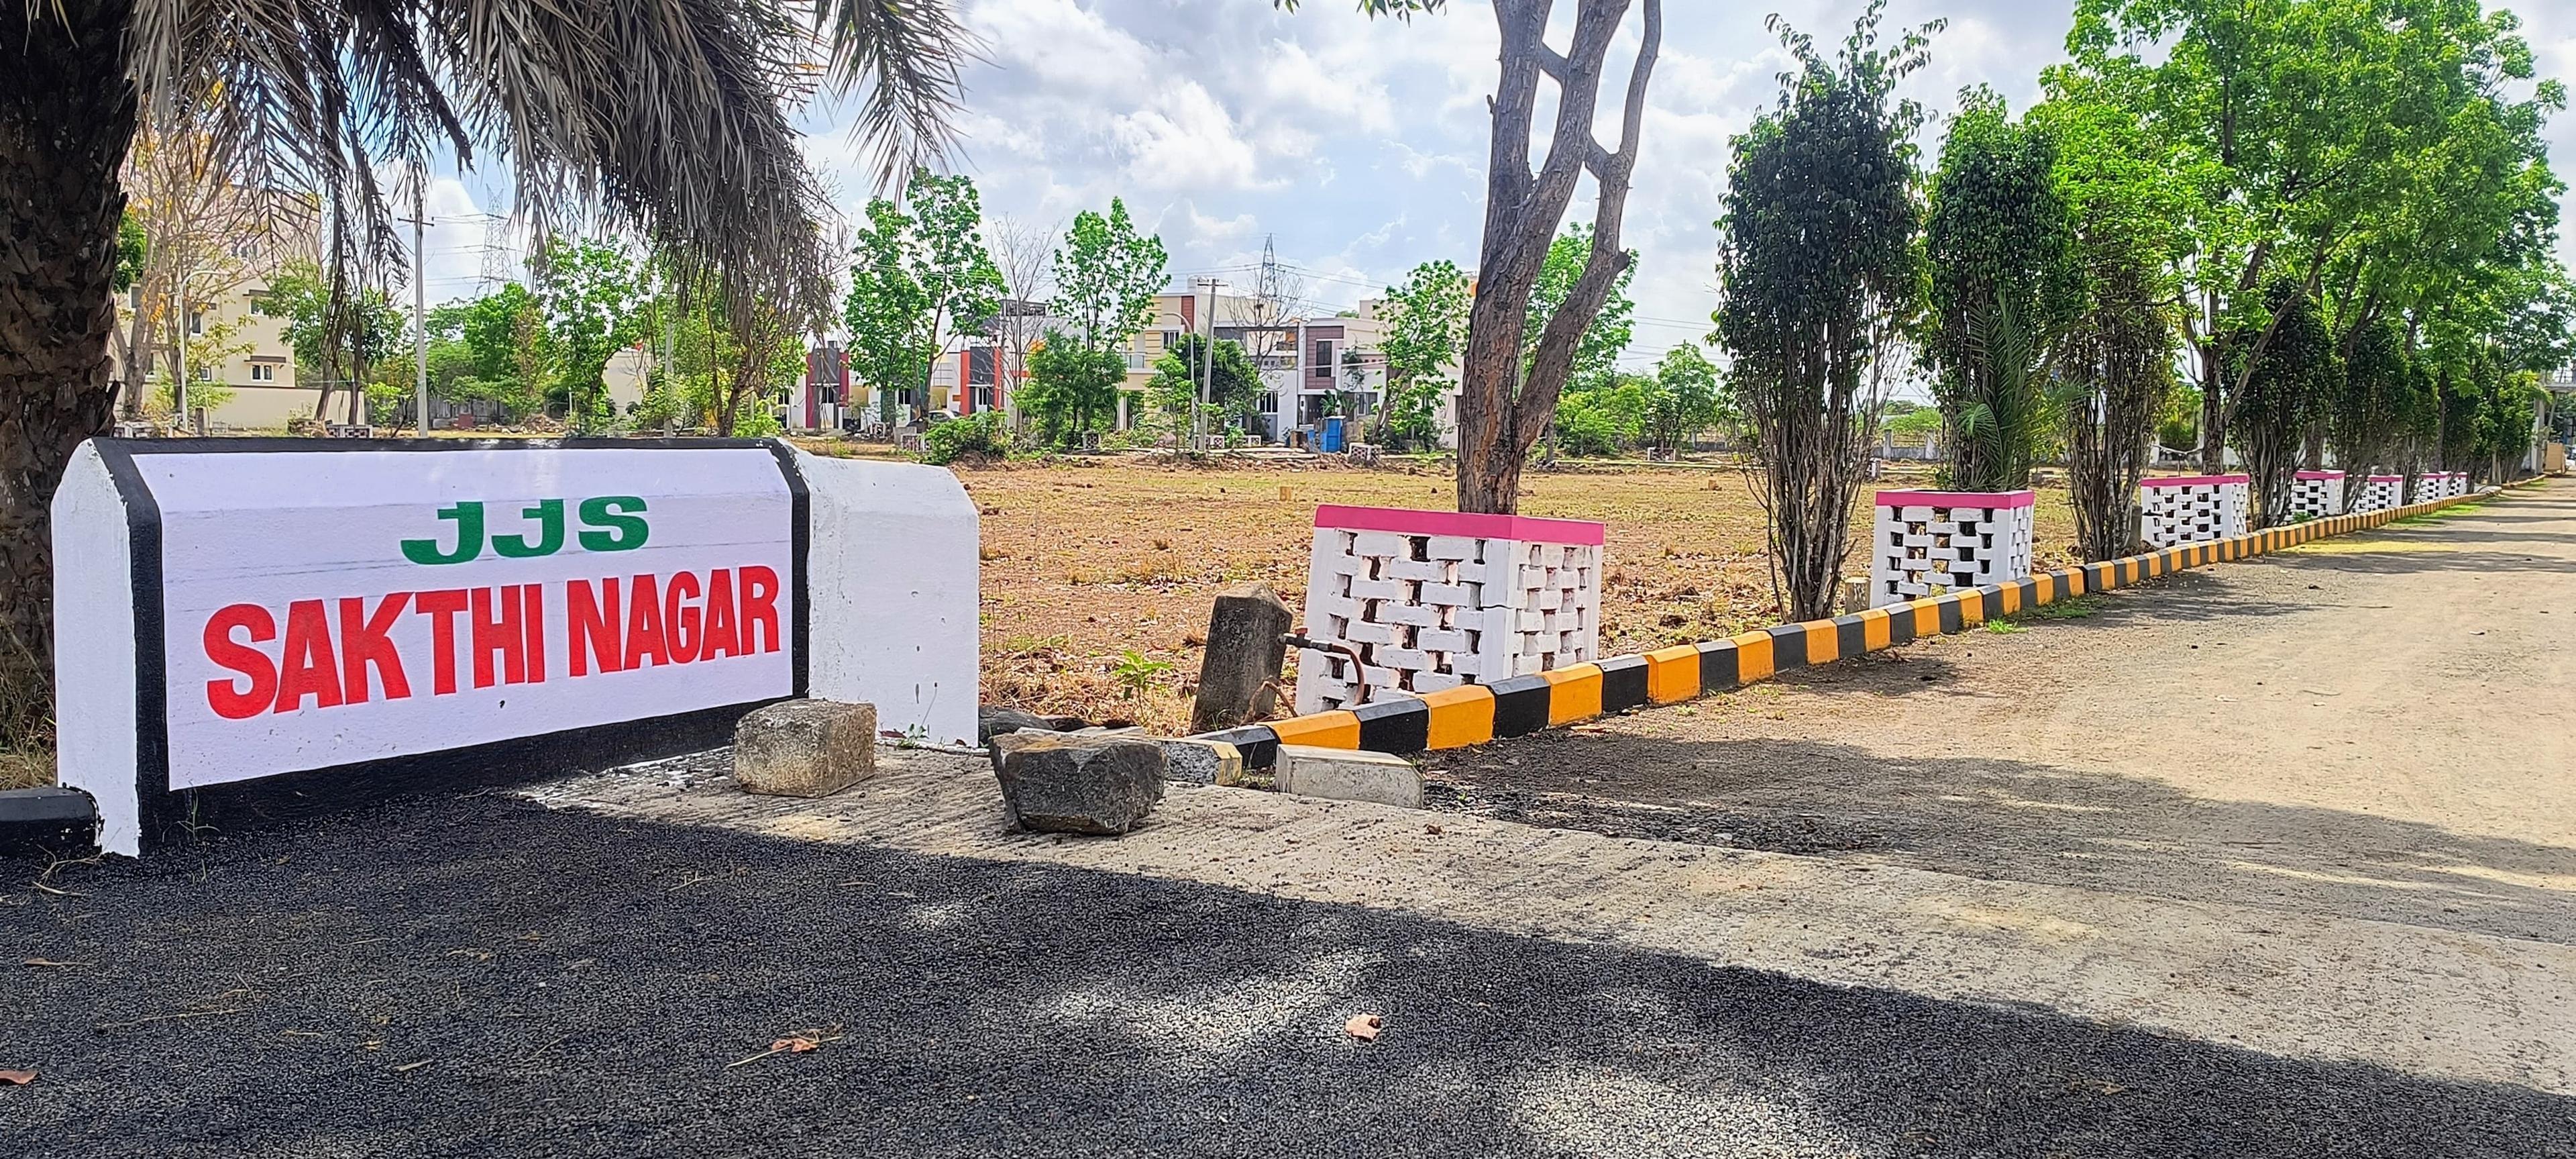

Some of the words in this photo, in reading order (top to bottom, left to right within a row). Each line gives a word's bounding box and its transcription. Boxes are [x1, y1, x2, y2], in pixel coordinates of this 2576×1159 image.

[400, 496, 649, 565] JJS
[203, 583, 546, 720] SAKTHI
[566, 565, 781, 678] NAGAR
